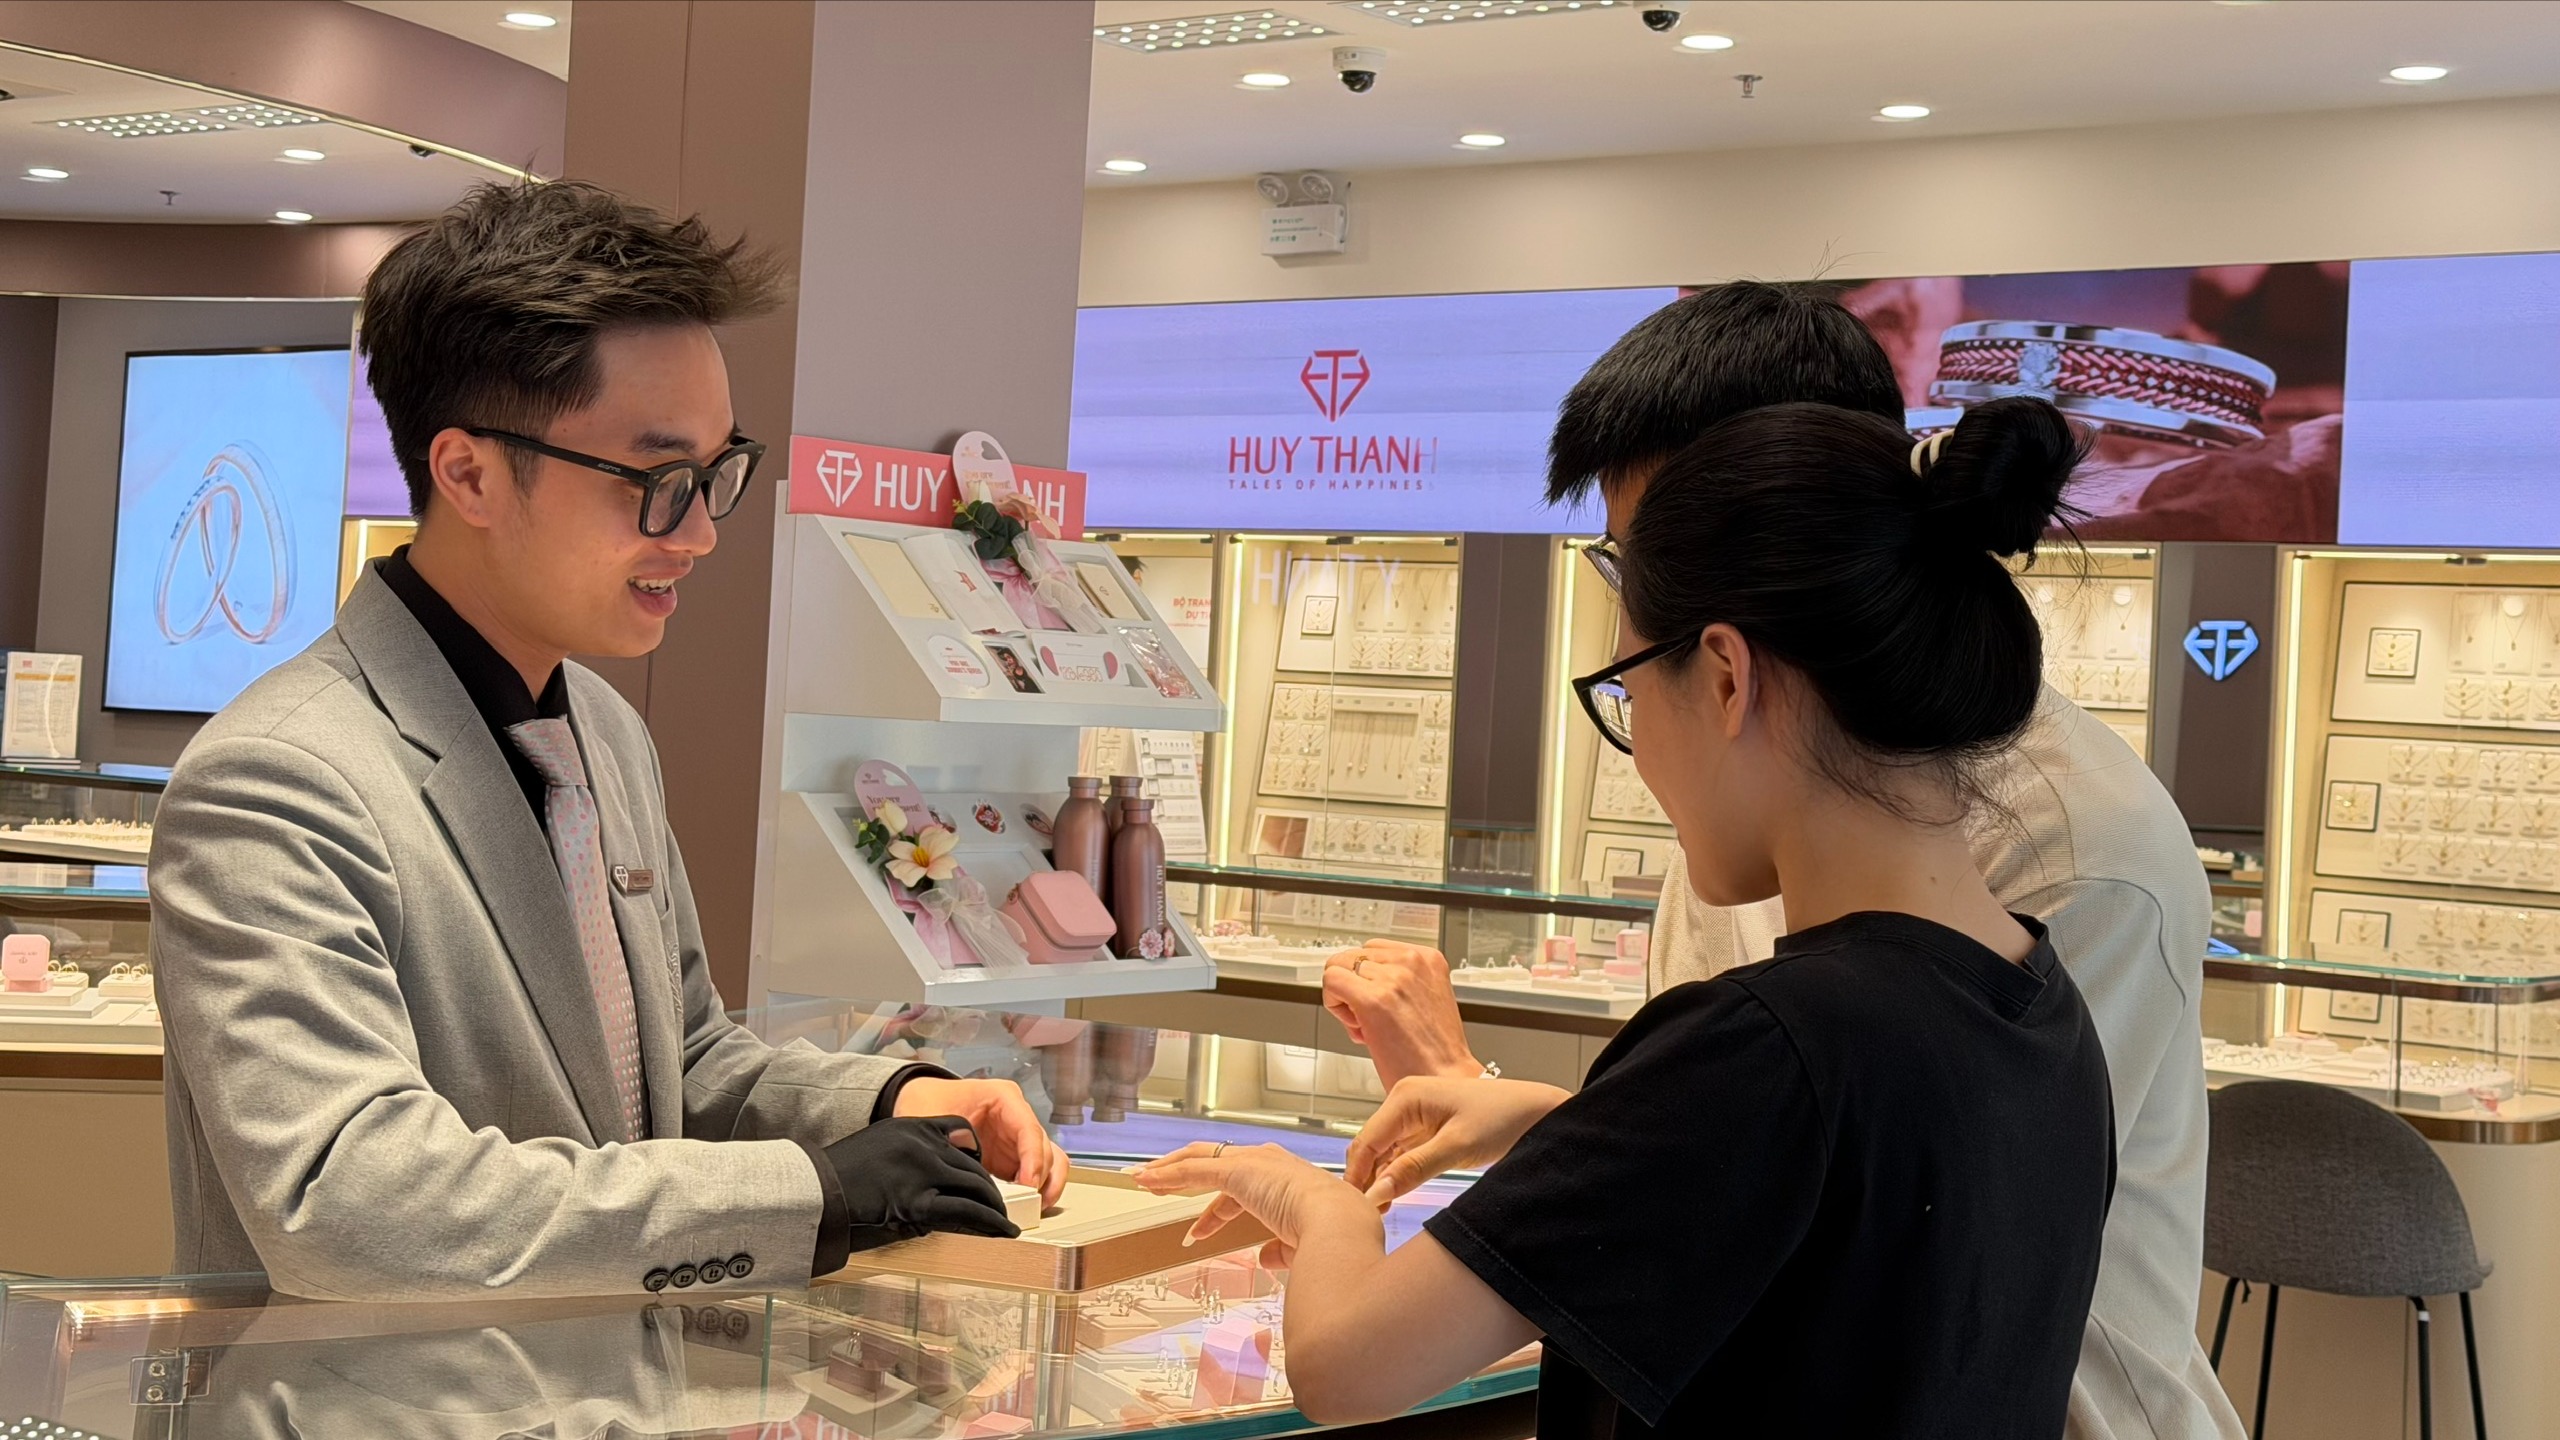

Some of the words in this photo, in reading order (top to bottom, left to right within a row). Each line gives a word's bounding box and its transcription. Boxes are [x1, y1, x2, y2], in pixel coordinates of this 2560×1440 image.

[1228, 436, 1302, 474] HUY
[874, 461, 947, 512] HUY
[1228, 479, 1282, 490] TALES
[1296, 479, 1316, 490] OF
[1329, 479, 1434, 490] HAPPINES
